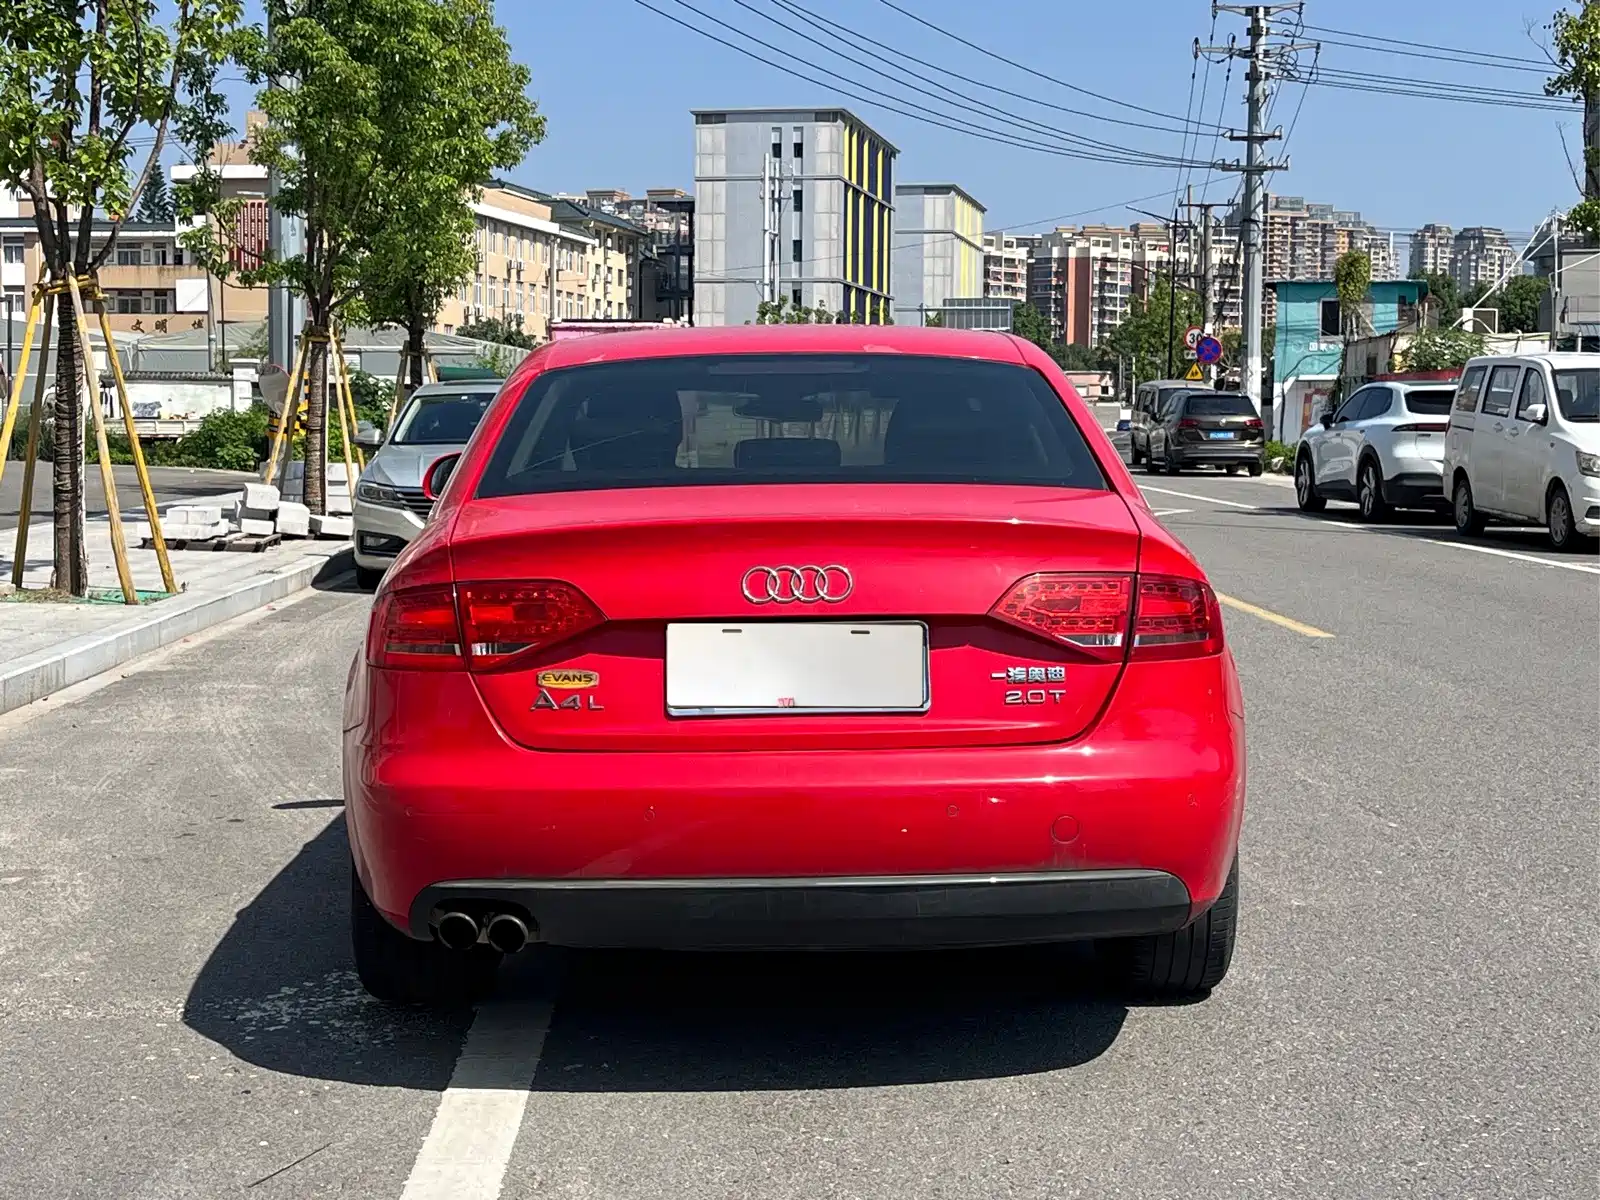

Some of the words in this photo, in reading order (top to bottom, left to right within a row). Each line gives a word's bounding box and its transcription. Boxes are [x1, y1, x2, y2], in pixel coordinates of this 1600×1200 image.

[541, 673, 594, 683] EVANS
[991, 666, 1066, 682] 一汽奥迪
[1005, 689, 1067, 704] 2.0T
